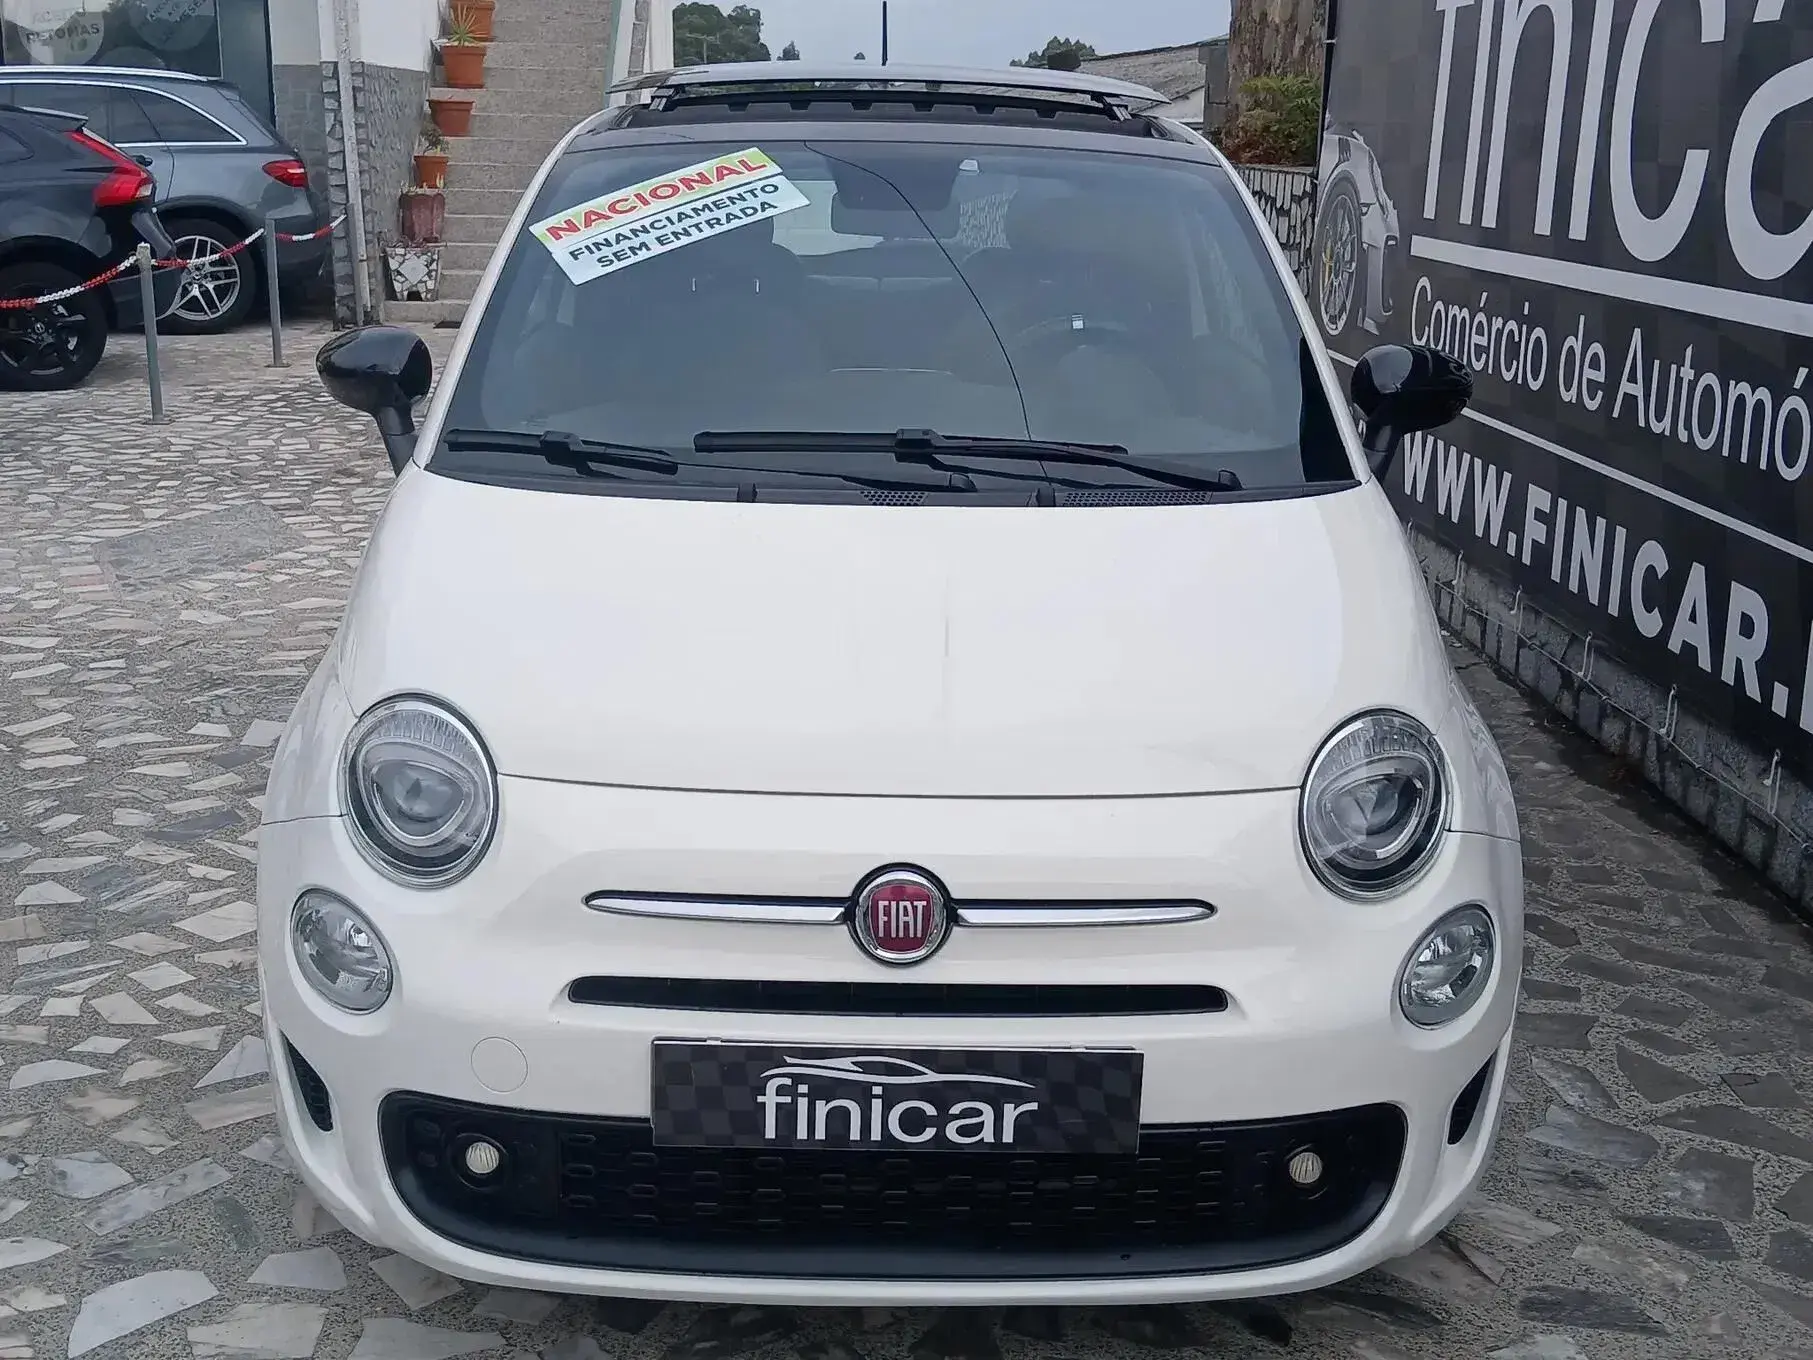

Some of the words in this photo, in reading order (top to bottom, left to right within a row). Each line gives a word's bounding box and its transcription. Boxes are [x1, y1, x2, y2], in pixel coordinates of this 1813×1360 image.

[546, 158, 767, 241] NACIONAL
[569, 183, 780, 261] FINANCIAMENTO
[597, 242, 651, 268] SEM
[658, 202, 778, 246] ENTRADA
[1411, 276, 1548, 391] Comércio
[1558, 314, 1606, 411] de
[1612, 327, 1811, 482] Automó
[878, 900, 927, 939] FIAT
[756, 1077, 1038, 1144] finicar
